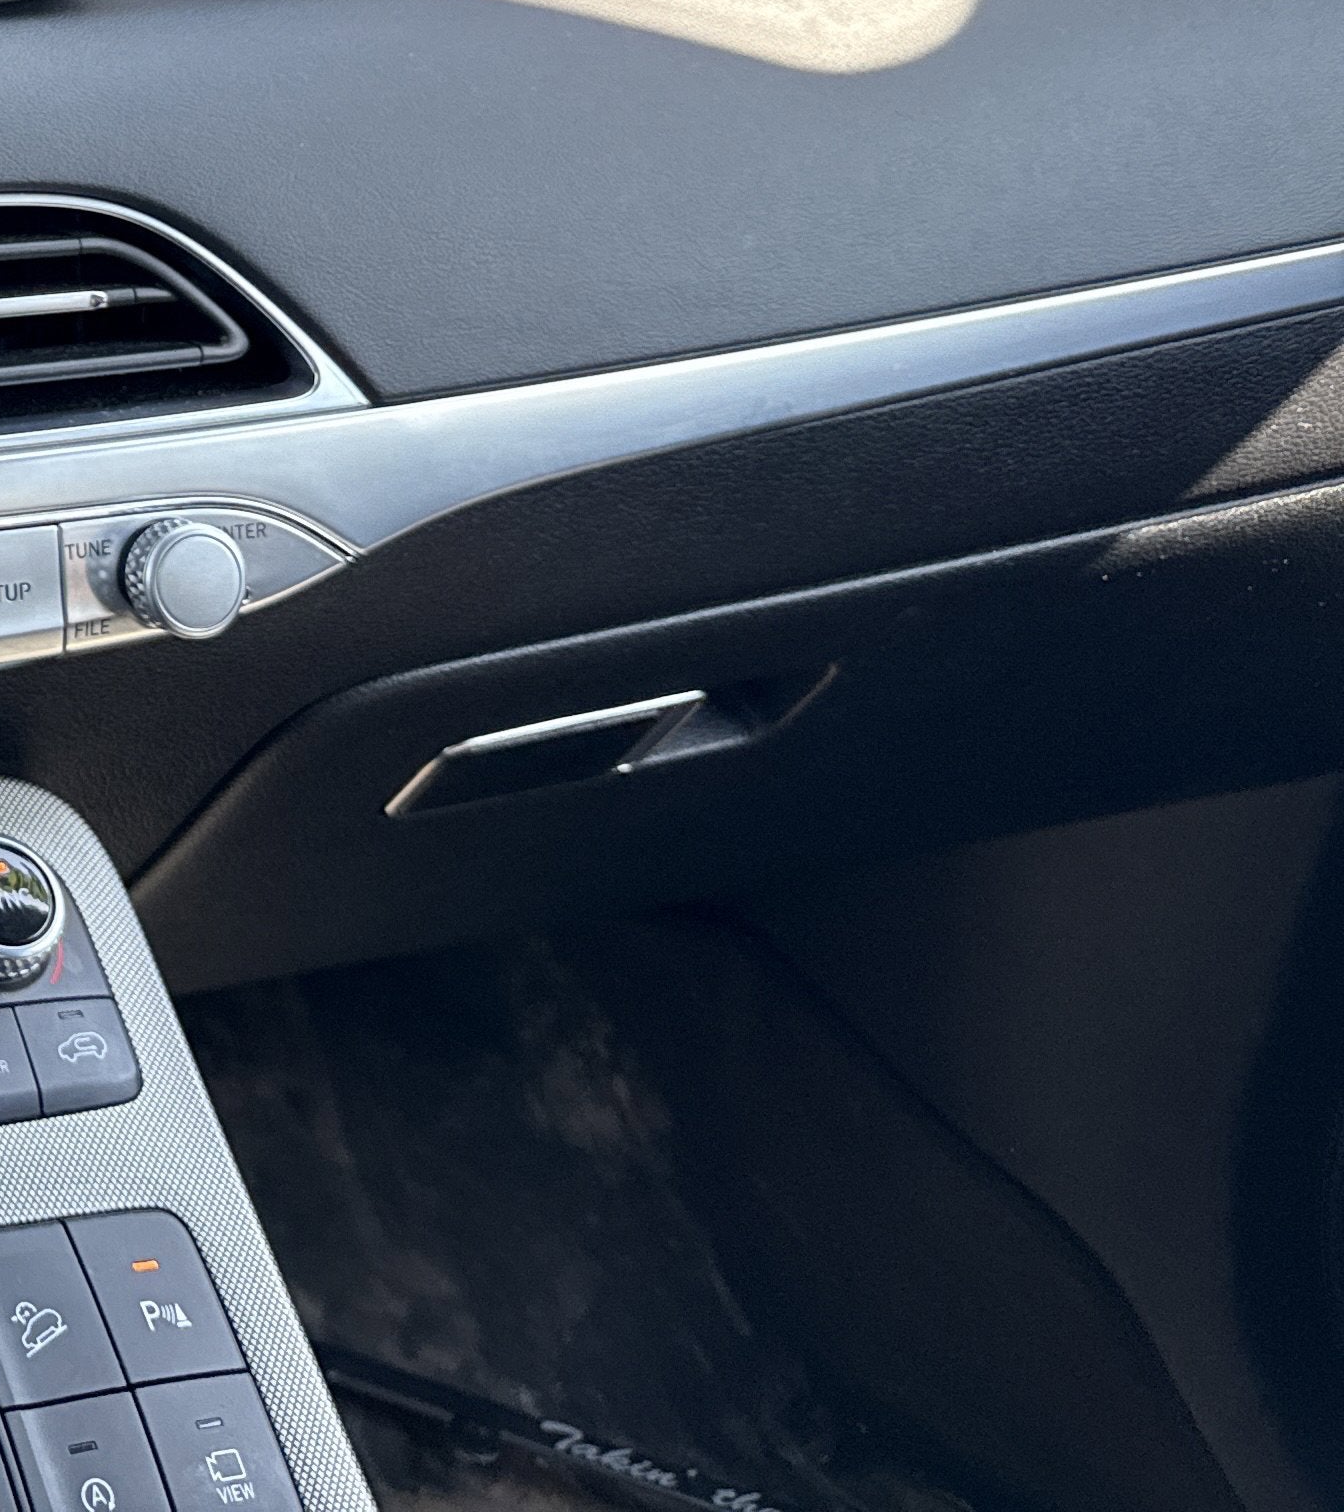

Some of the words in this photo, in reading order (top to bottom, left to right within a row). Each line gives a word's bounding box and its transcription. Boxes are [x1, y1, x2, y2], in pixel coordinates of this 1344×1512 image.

[218, 522, 267, 539] NTER
[65, 539, 111, 560] TUNE
[74, 618, 111, 638] FILE
[216, 1481, 255, 1504] VIEW
